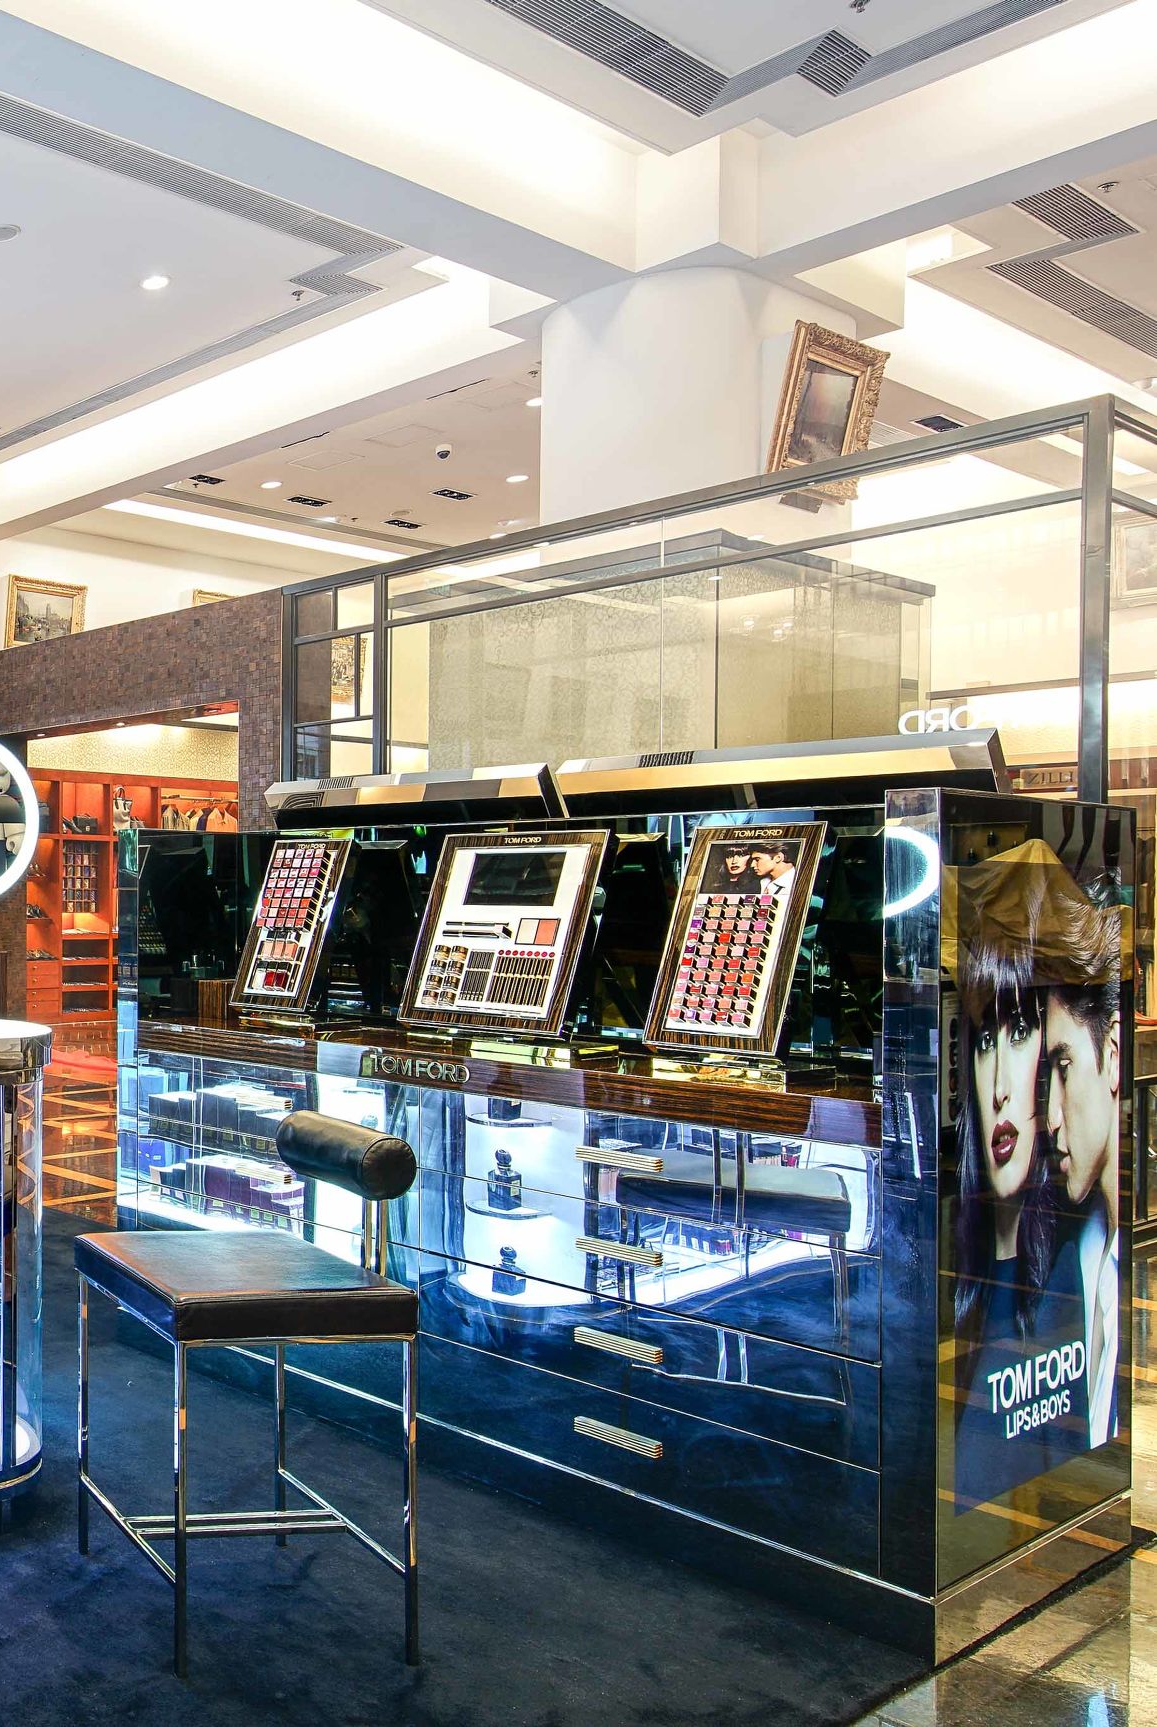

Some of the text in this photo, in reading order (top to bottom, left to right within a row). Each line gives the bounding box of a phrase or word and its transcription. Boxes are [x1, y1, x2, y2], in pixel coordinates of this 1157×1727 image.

[1026, 771, 1074, 784] ZILLI
[520, 836, 542, 844] FORD
[733, 829, 783, 838] TOM FORD
[370, 1053, 470, 1084] TOM FORD
[987, 1340, 1086, 1414] TOM FORD
[1005, 1389, 1071, 1440] LIPS&BOYS
